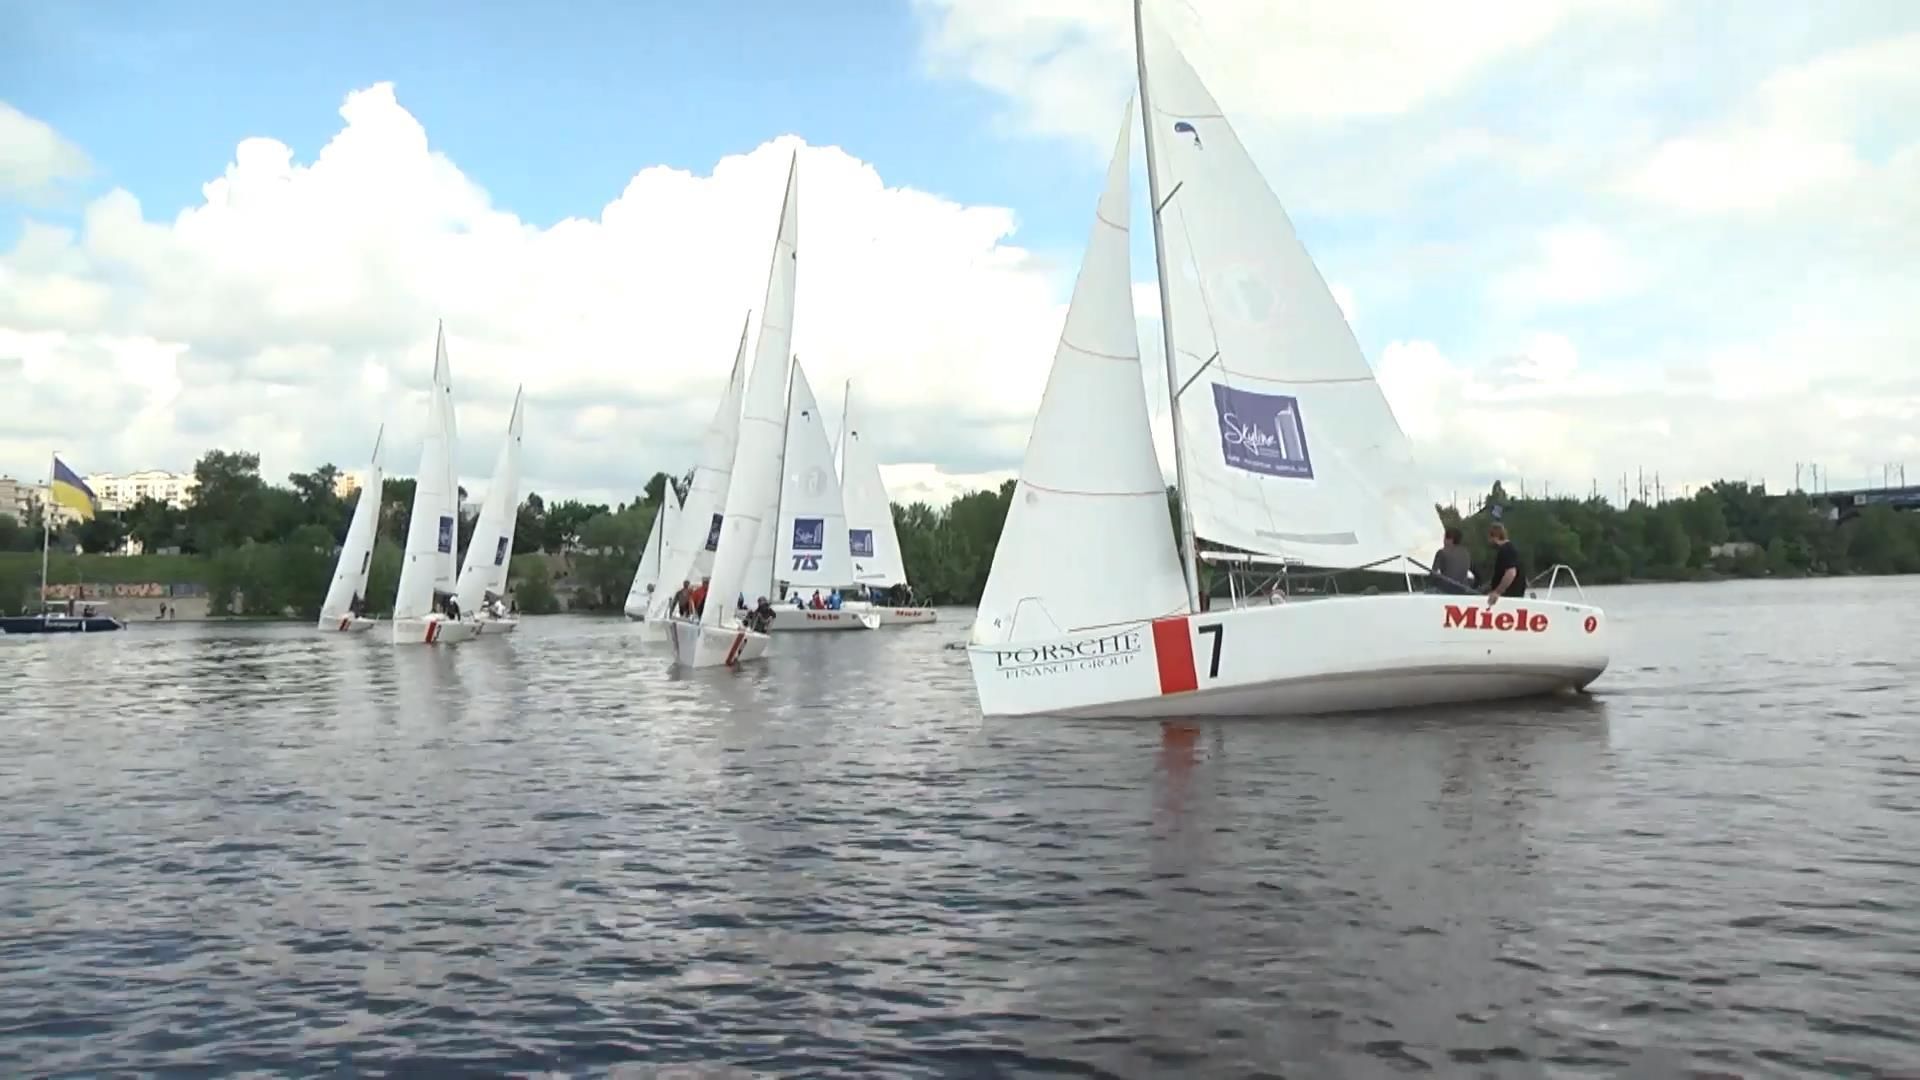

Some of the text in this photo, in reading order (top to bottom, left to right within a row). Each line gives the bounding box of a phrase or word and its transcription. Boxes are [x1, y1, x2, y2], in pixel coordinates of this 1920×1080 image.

[1223, 411, 1275, 456] Skyline
[1443, 605, 1548, 632] Miele
[996, 633, 1141, 666] PORSCHE
[1198, 623, 1223, 678] 7
[1005, 655, 1134, 679] FINANCE GROUP
